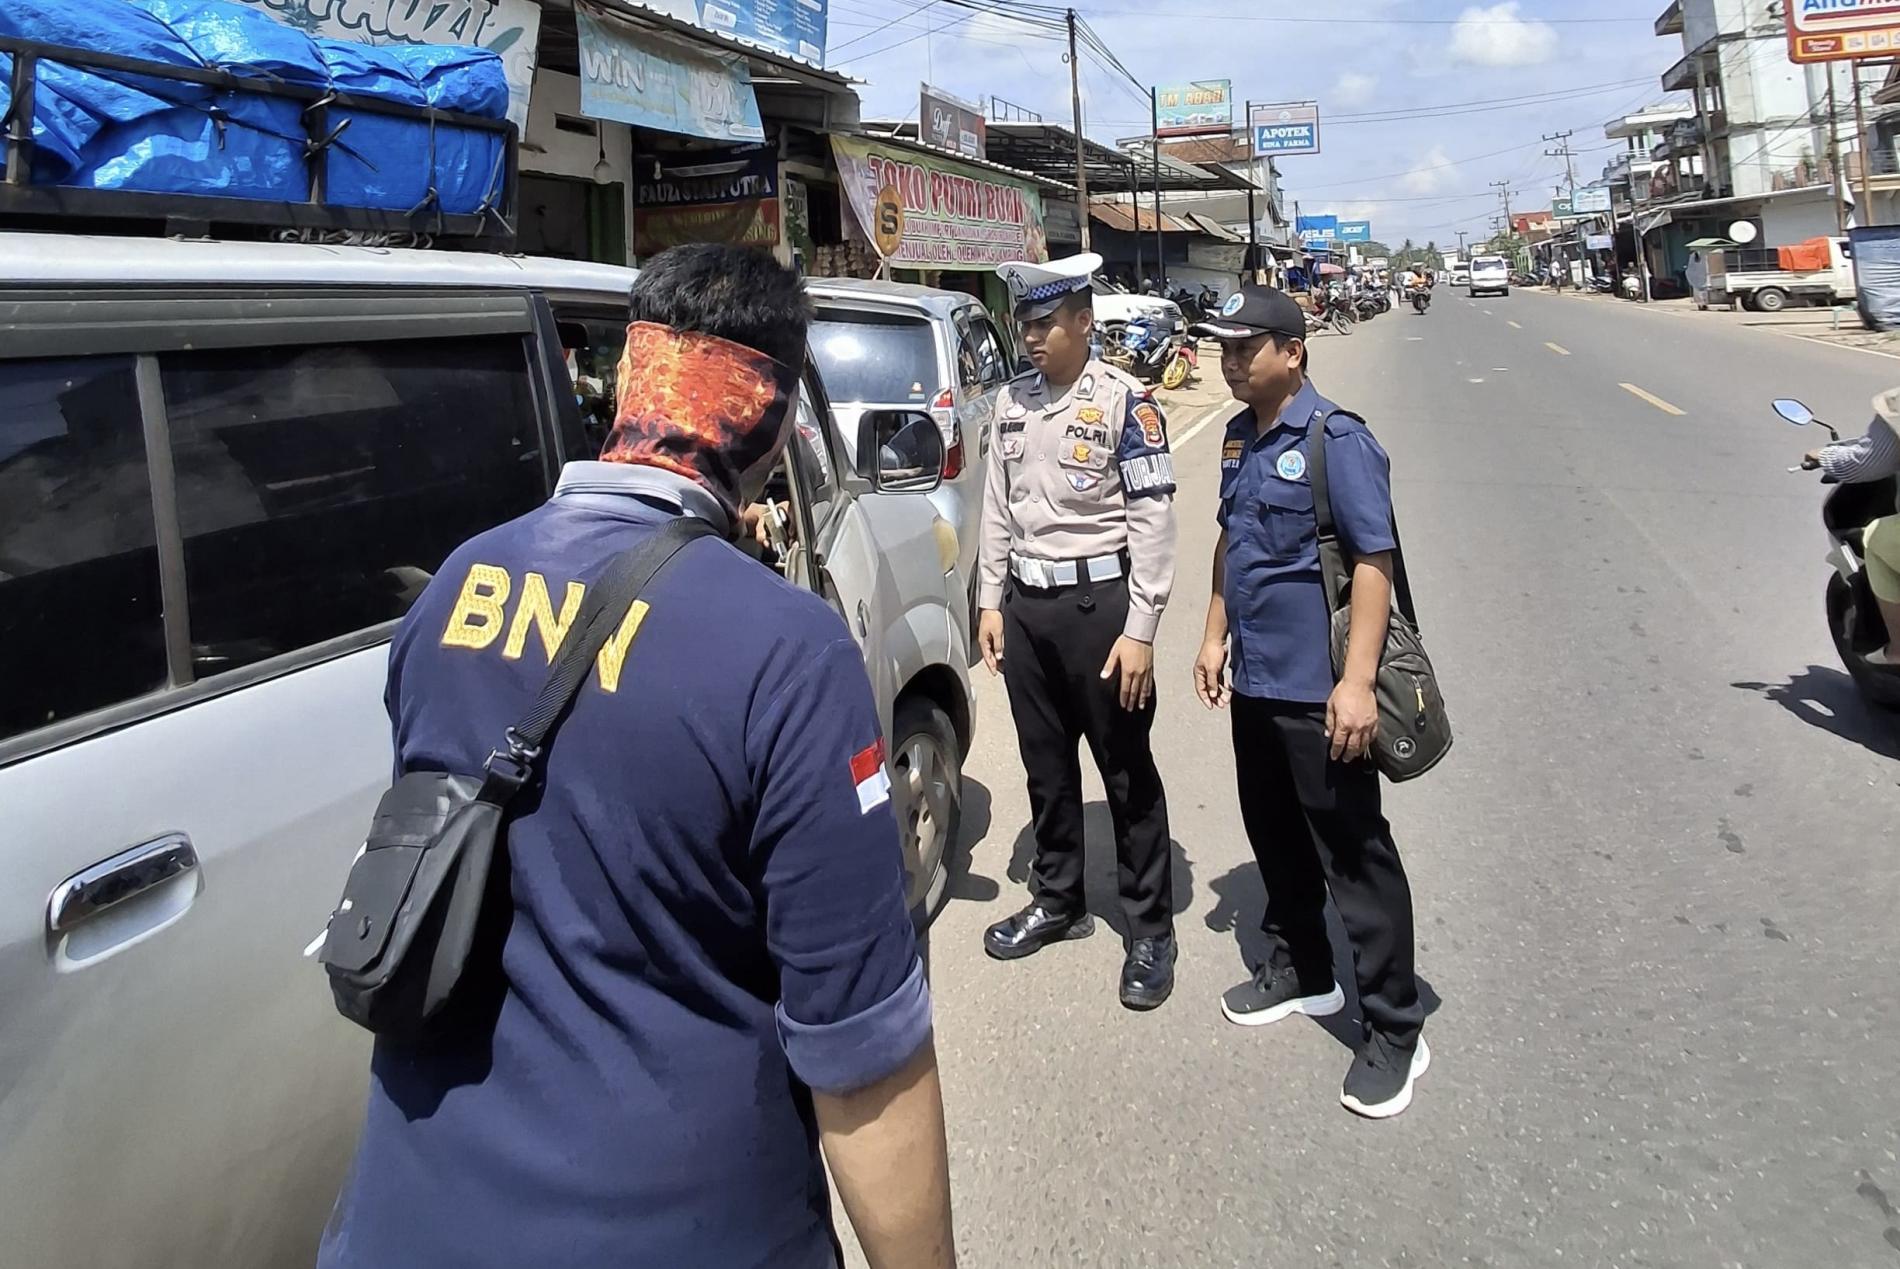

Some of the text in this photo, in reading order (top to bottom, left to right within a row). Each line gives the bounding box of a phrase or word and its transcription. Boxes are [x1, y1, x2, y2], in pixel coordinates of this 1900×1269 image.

[1261, 126, 1310, 139] APOTEK
[868, 154, 928, 213] TOKO
[930, 170, 983, 221] PUTRI
[881, 203, 898, 234] S
[1299, 228, 1335, 239] ASUS
[1342, 225, 1366, 234] acer
[932, 243, 952, 261] OLEH
[1066, 424, 1107, 444] POLRI
[1119, 453, 1176, 492] TURJA
